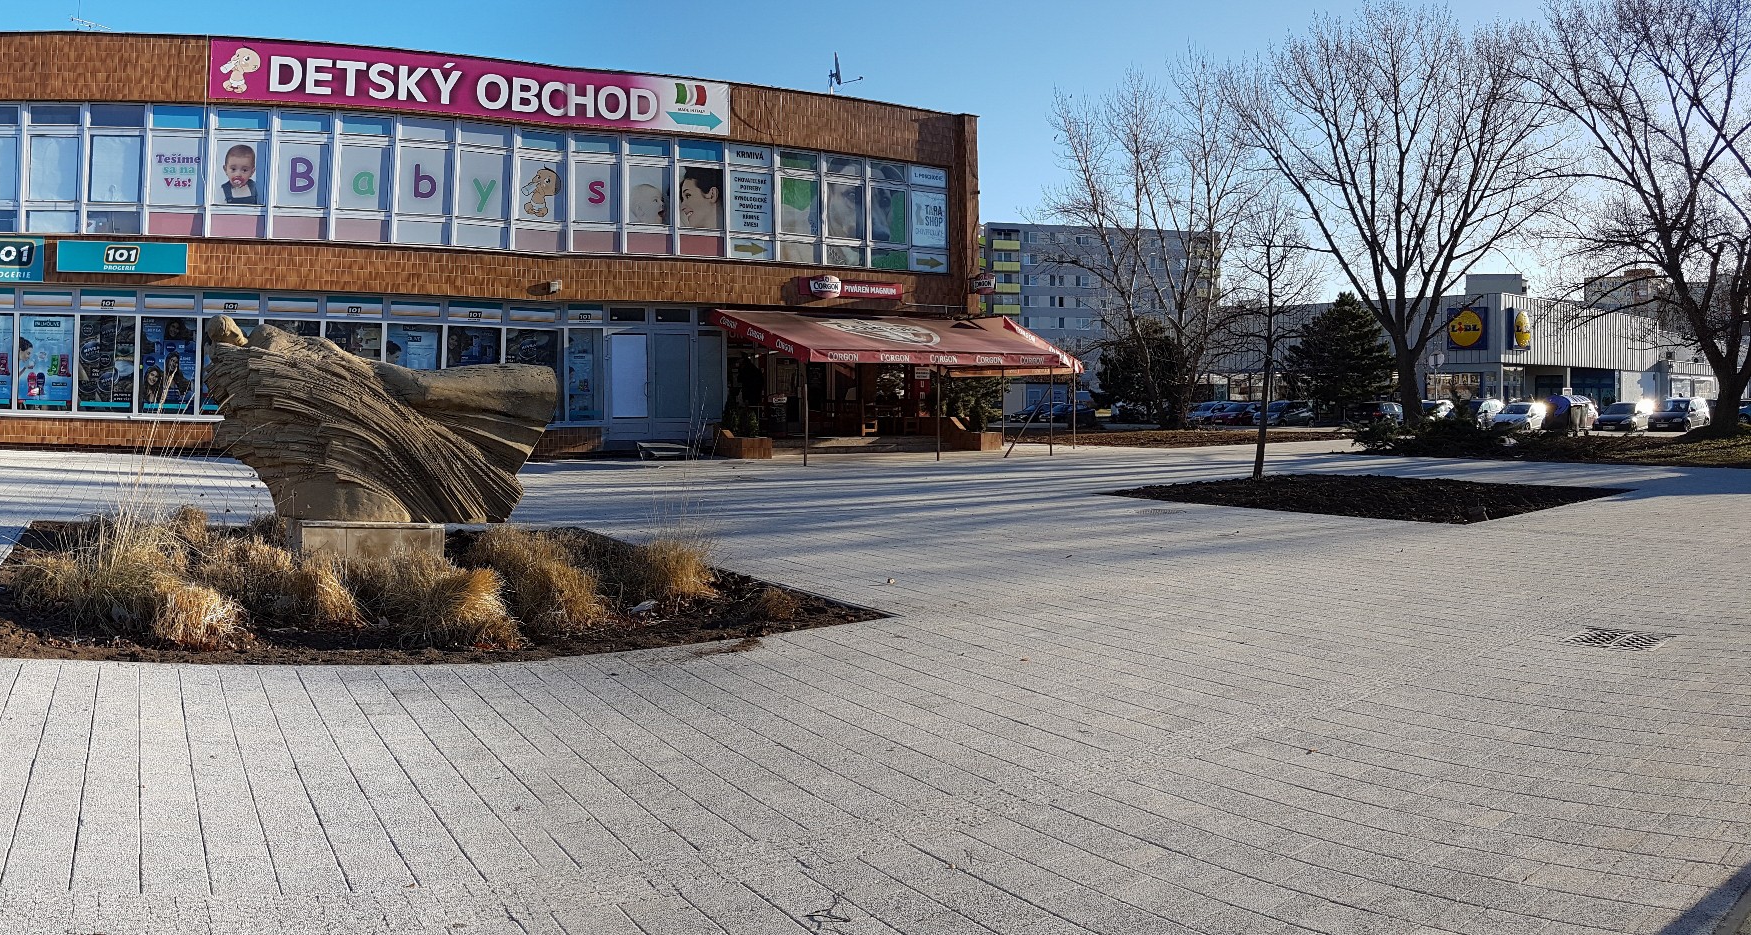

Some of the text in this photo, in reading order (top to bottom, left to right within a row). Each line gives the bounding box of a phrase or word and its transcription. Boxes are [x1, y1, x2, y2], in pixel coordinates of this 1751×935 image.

[268, 55, 658, 122] DETSKÝ OBCHOD
[155, 153, 201, 164] Tešíme
[736, 150, 764, 161] KRMIVÁ
[163, 166, 195, 174] sa na
[164, 177, 192, 187] Vás!
[740, 184, 762, 192] POTREBY
[924, 204, 943, 217] TARA
[924, 216, 944, 227] SHOP
[107, 248, 137, 262] 101
[844, 283, 897, 295] PIVÁREŇ MAGNUM
[1450, 322, 1480, 334] LIDL
